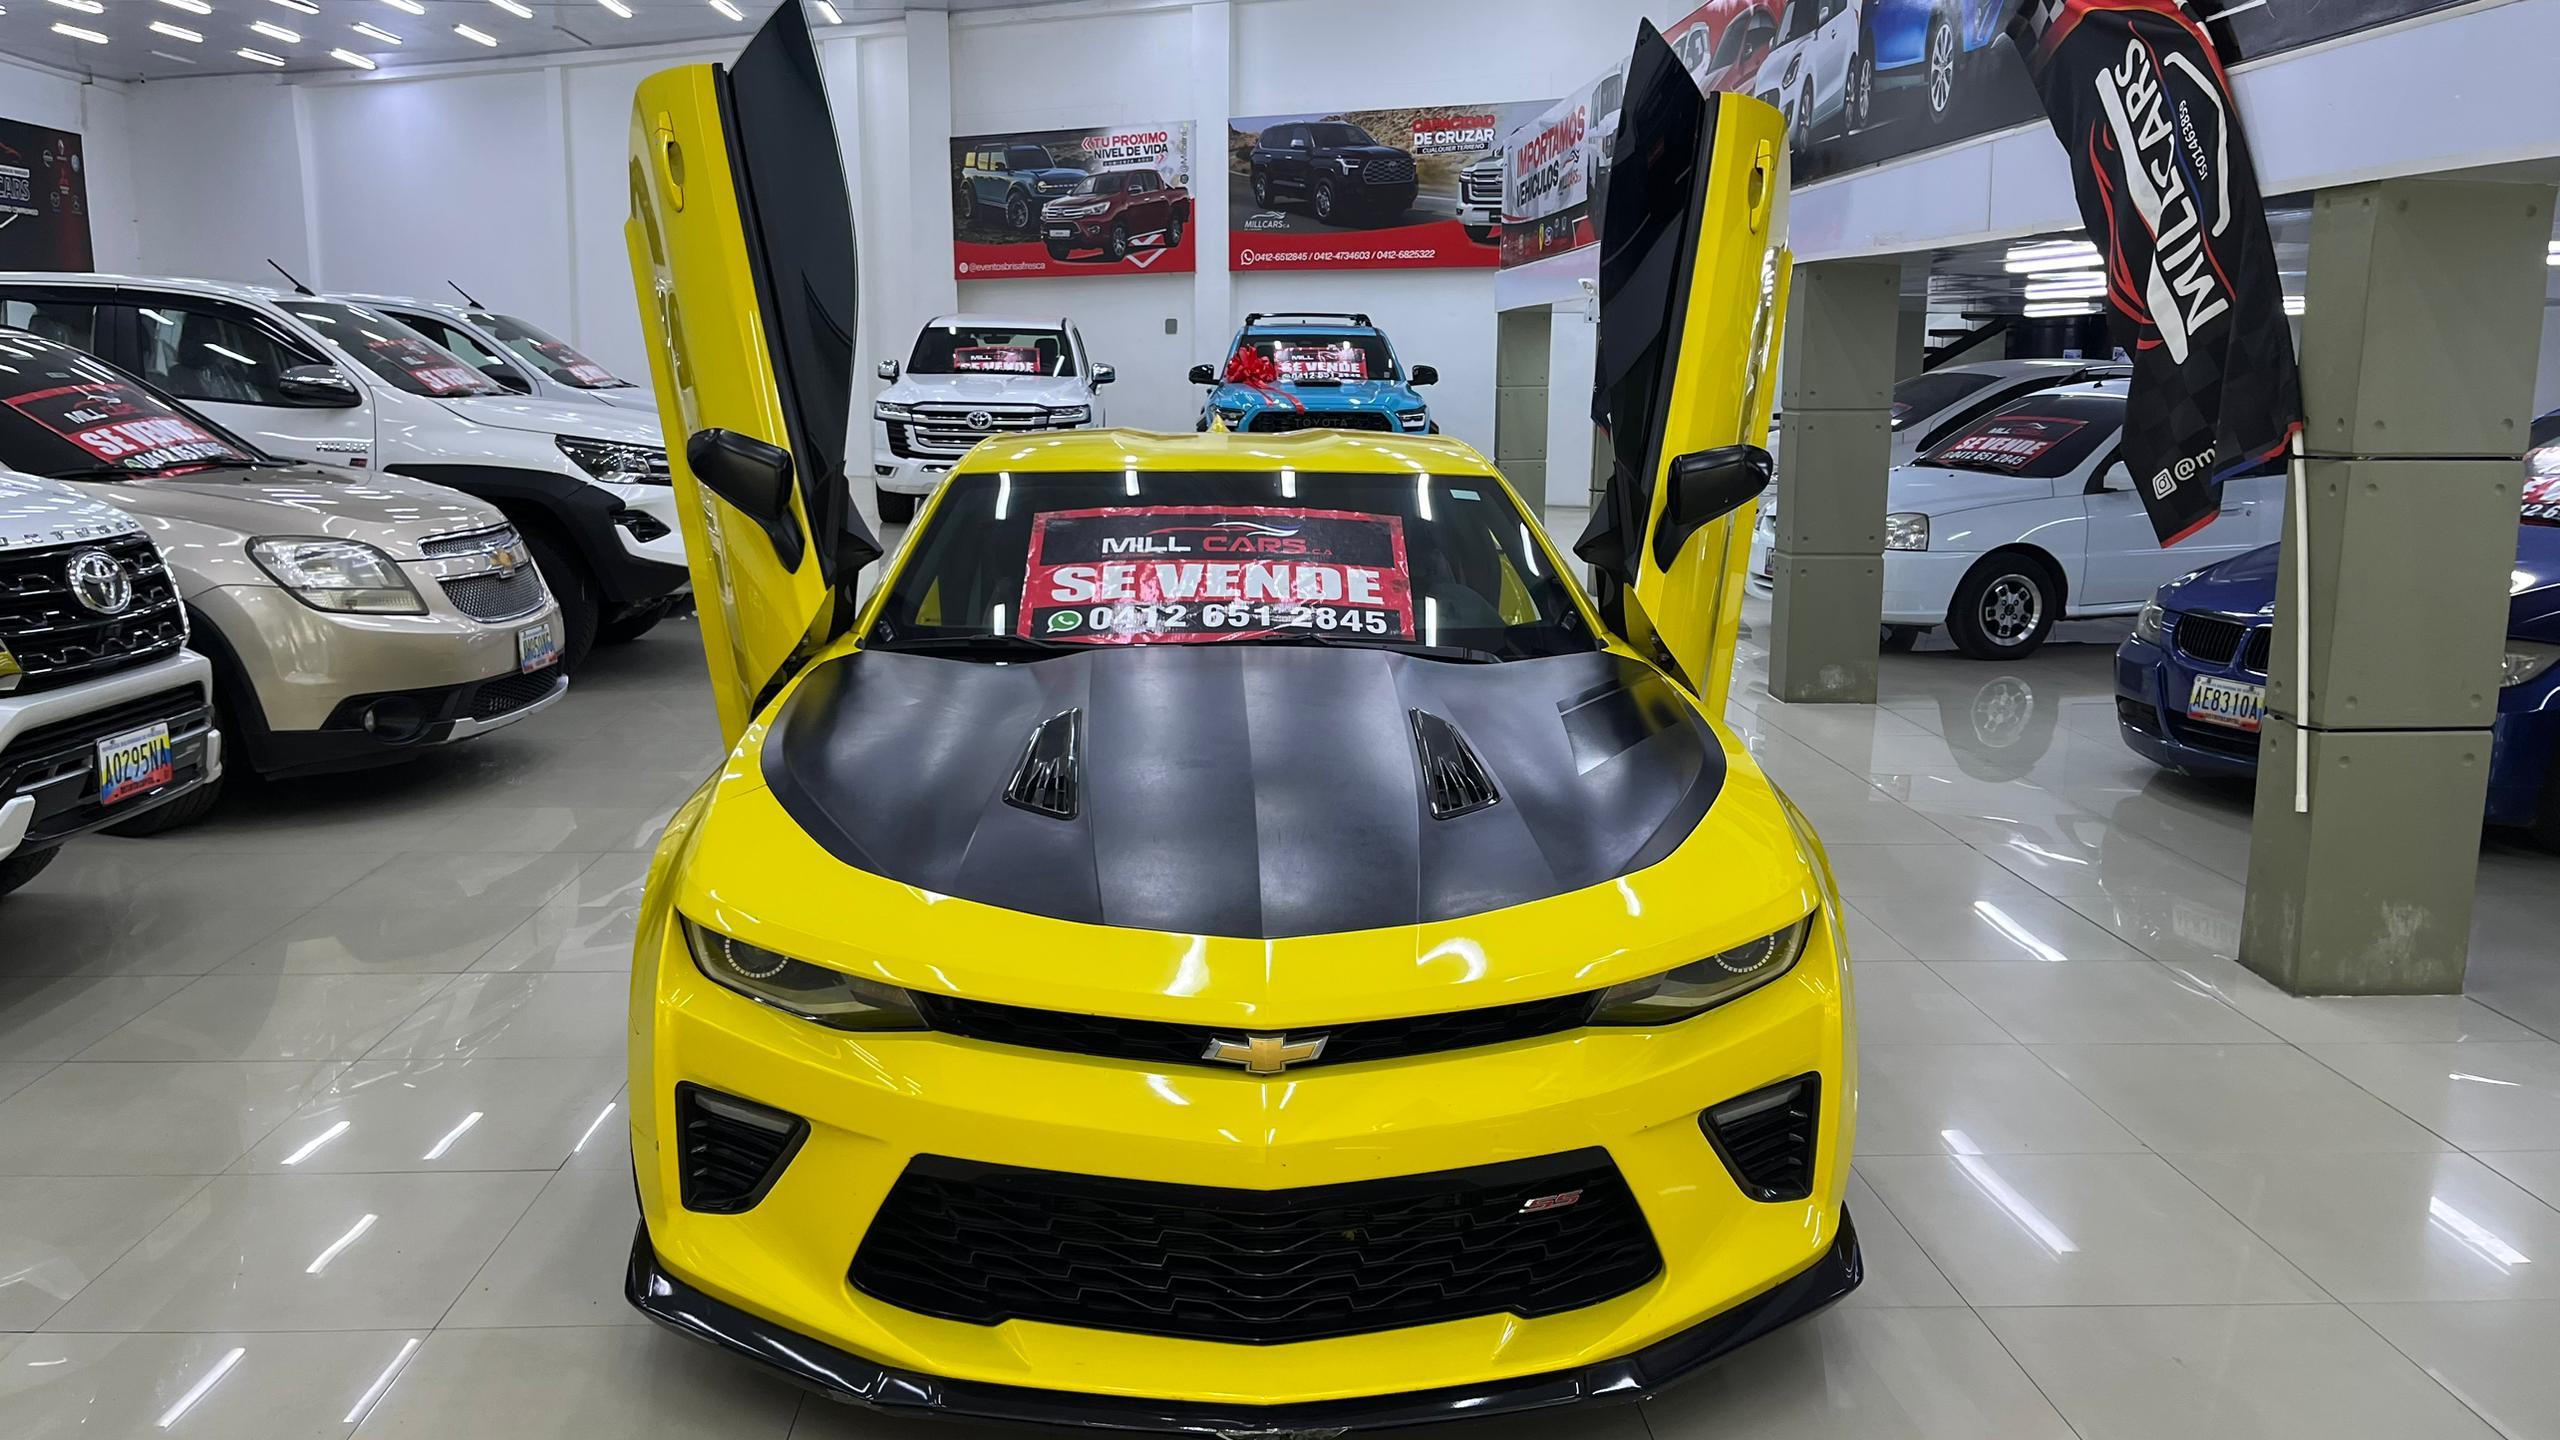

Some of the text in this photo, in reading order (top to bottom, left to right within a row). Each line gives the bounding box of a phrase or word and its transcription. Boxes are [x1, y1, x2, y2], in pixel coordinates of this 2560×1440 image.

[1094, 131, 1168, 148] TU PROXIMO
[1414, 128, 1495, 145] DE CRUZAR
[1516, 105, 1586, 179] IMPORTAMOS
[1094, 144, 1169, 159] NIVEL DE VIDA
[1422, 143, 1485, 154] CUALQUIER TERRENO
[1255, 252, 1307, 262] 0412-6512845
[1314, 251, 1370, 260] 0412-4734603
[1376, 249, 1436, 259] 0412-6825322
[1305, 361, 1360, 373] VENDE
[1294, 418, 1348, 428] TOYOTA
[80, 428, 138, 455] SE
[1955, 437, 2048, 455] SE VENDE
[2174, 440, 2217, 481] @m
[1102, 536, 1191, 553] MILL
[1202, 536, 1307, 554] CARS
[1051, 562, 1386, 605] SE VENDE
[1089, 603, 1388, 634] 0412 651 2845
